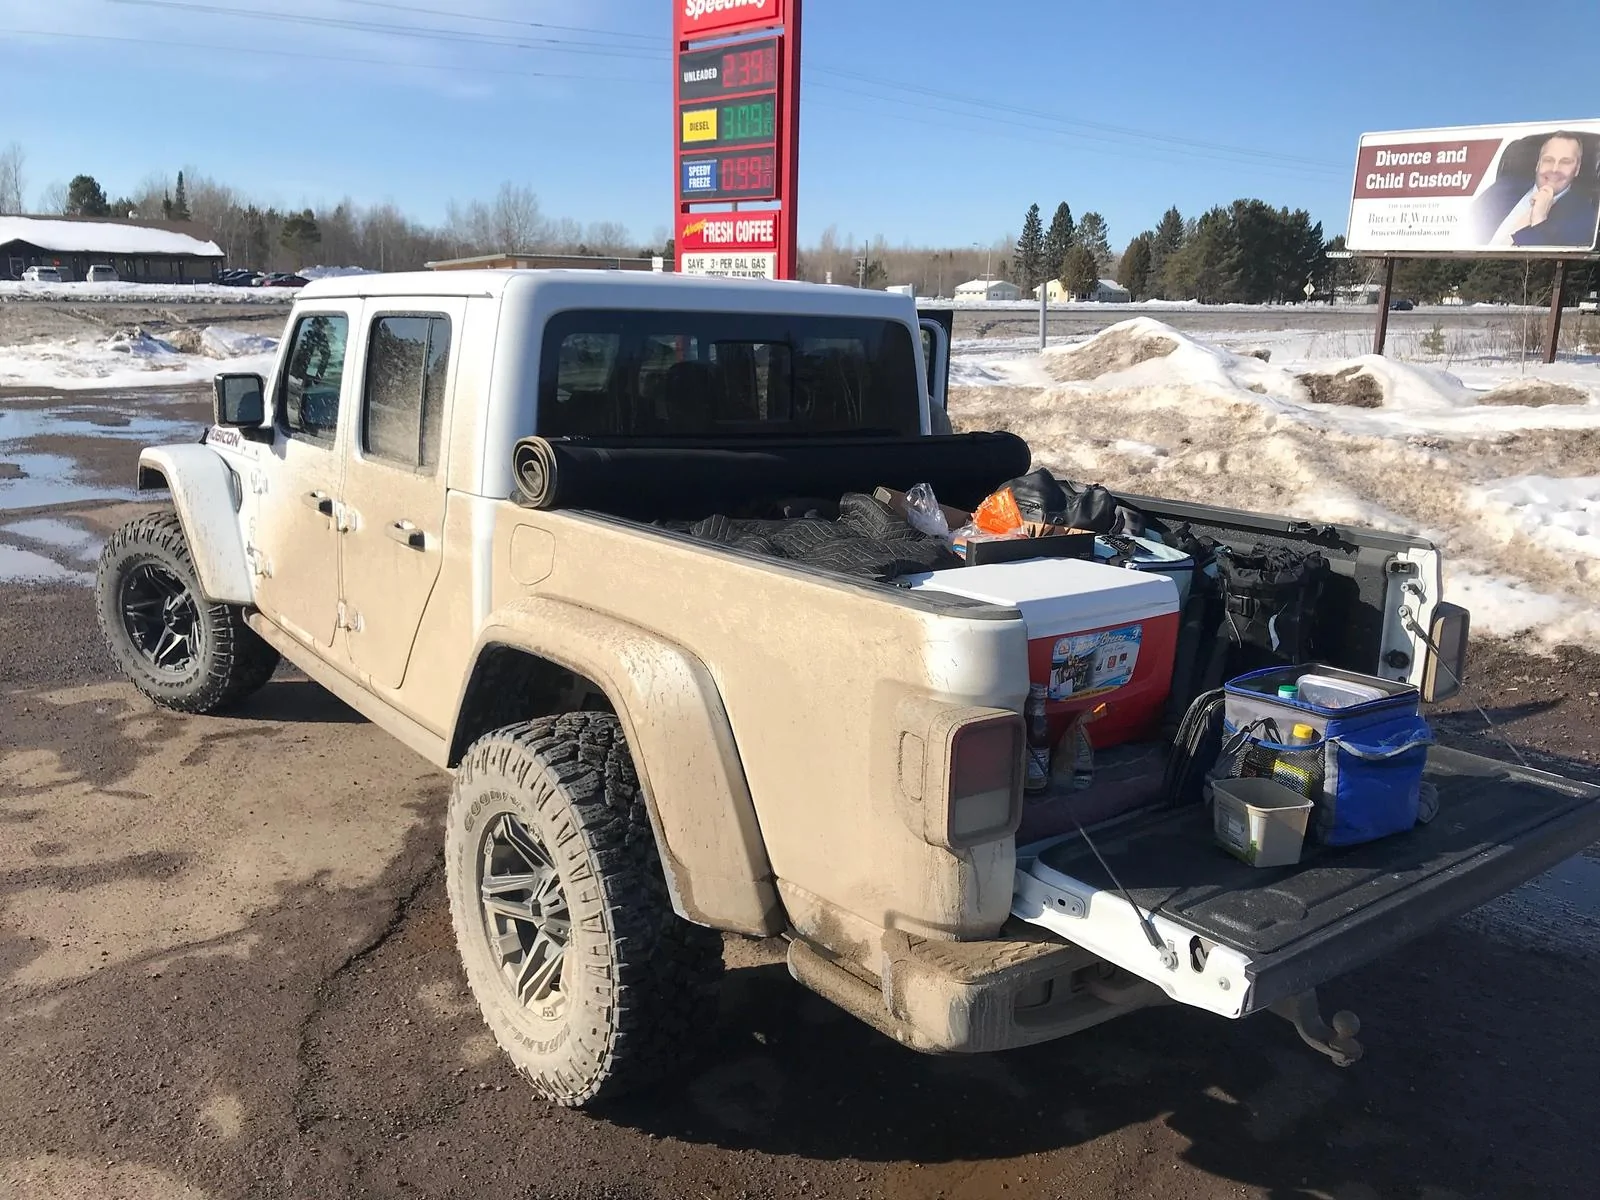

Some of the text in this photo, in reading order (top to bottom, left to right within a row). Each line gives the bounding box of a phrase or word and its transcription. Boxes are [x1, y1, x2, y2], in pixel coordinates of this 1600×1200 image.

[683, 67, 718, 82] UNLEADED
[689, 121, 710, 131] DIESEL
[1375, 146, 1468, 167] Divorce and
[688, 164, 711, 177] SPEEDY
[688, 176, 711, 188] FREEZE
[1365, 170, 1472, 190] Child Custody
[703, 220, 774, 243] FRESH COFFEE
[687, 258, 704, 269] SAVE
[719, 258, 732, 269] PER
[734, 258, 749, 269] GAL
[751, 258, 766, 269] GAS
[464, 790, 527, 833] GOODY
